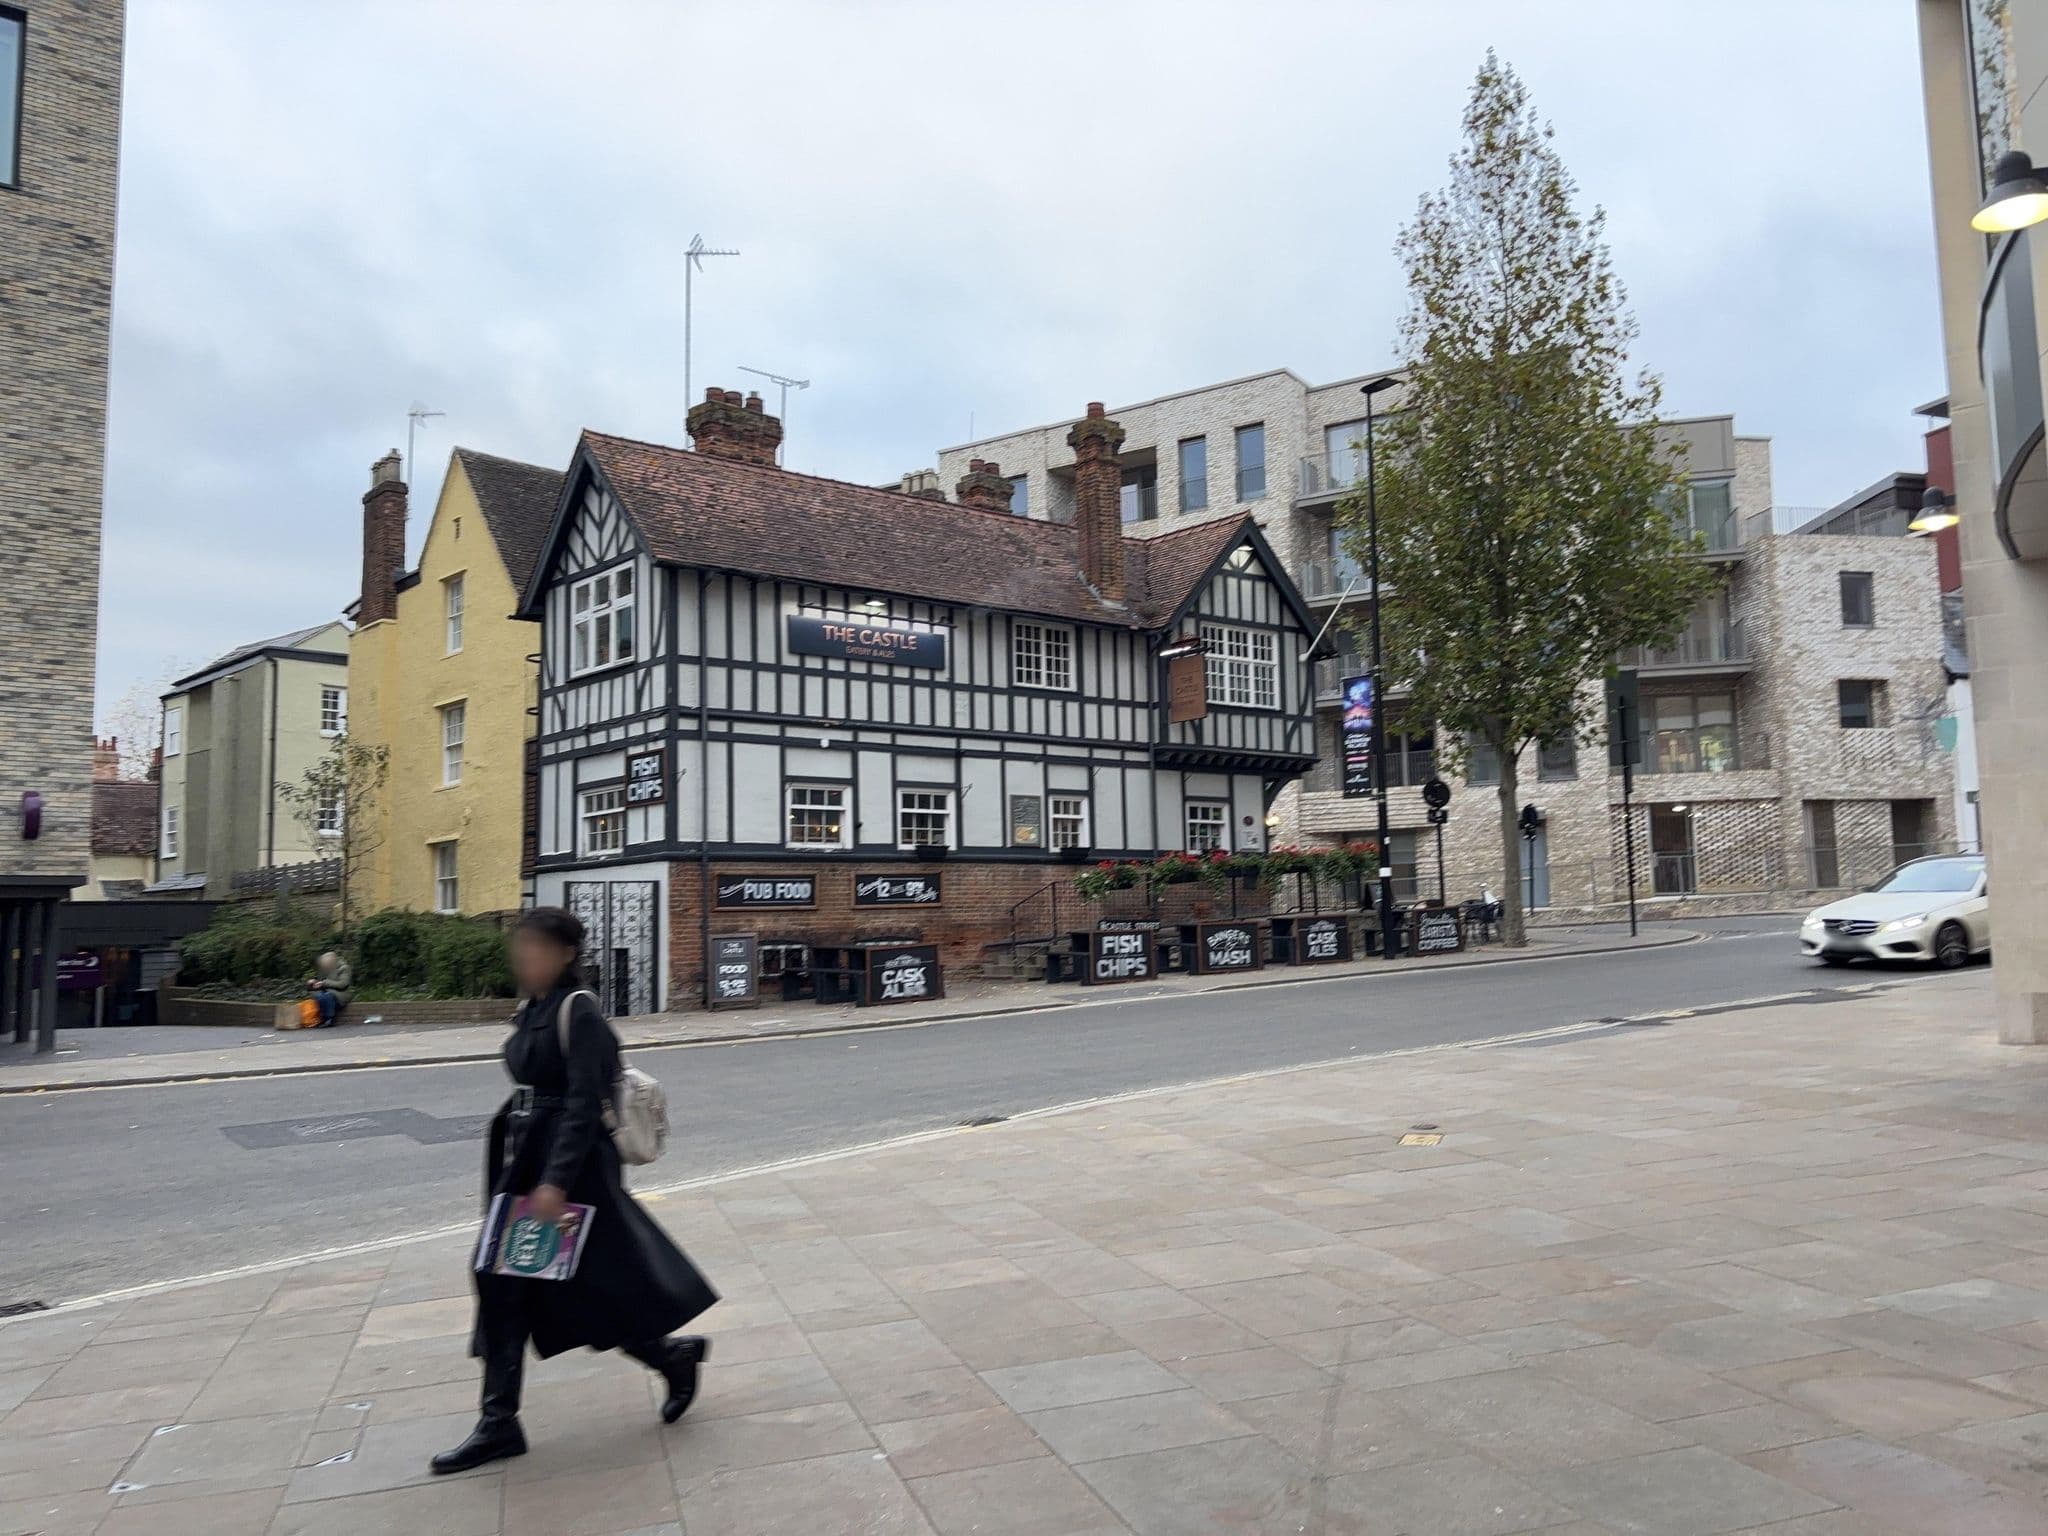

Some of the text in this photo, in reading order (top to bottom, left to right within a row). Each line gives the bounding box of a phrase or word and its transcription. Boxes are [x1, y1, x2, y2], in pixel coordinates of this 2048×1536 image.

[822, 624, 918, 650] THE CASTLE
[631, 755, 660, 779] FISH
[627, 779, 663, 802] CHIPS
[743, 882, 773, 900] PUB
[775, 882, 812, 899] FOOD
[877, 882, 891, 898] 12
[1102, 934, 1143, 955] FISH
[1307, 931, 1338, 946] CASK
[1209, 949, 1251, 966] MASH
[1307, 943, 1338, 958] ALES
[719, 964, 748, 975] FOOD
[881, 967, 927, 985] CASK
[1096, 957, 1148, 978] CHIPS
[880, 981, 928, 999] ALES
